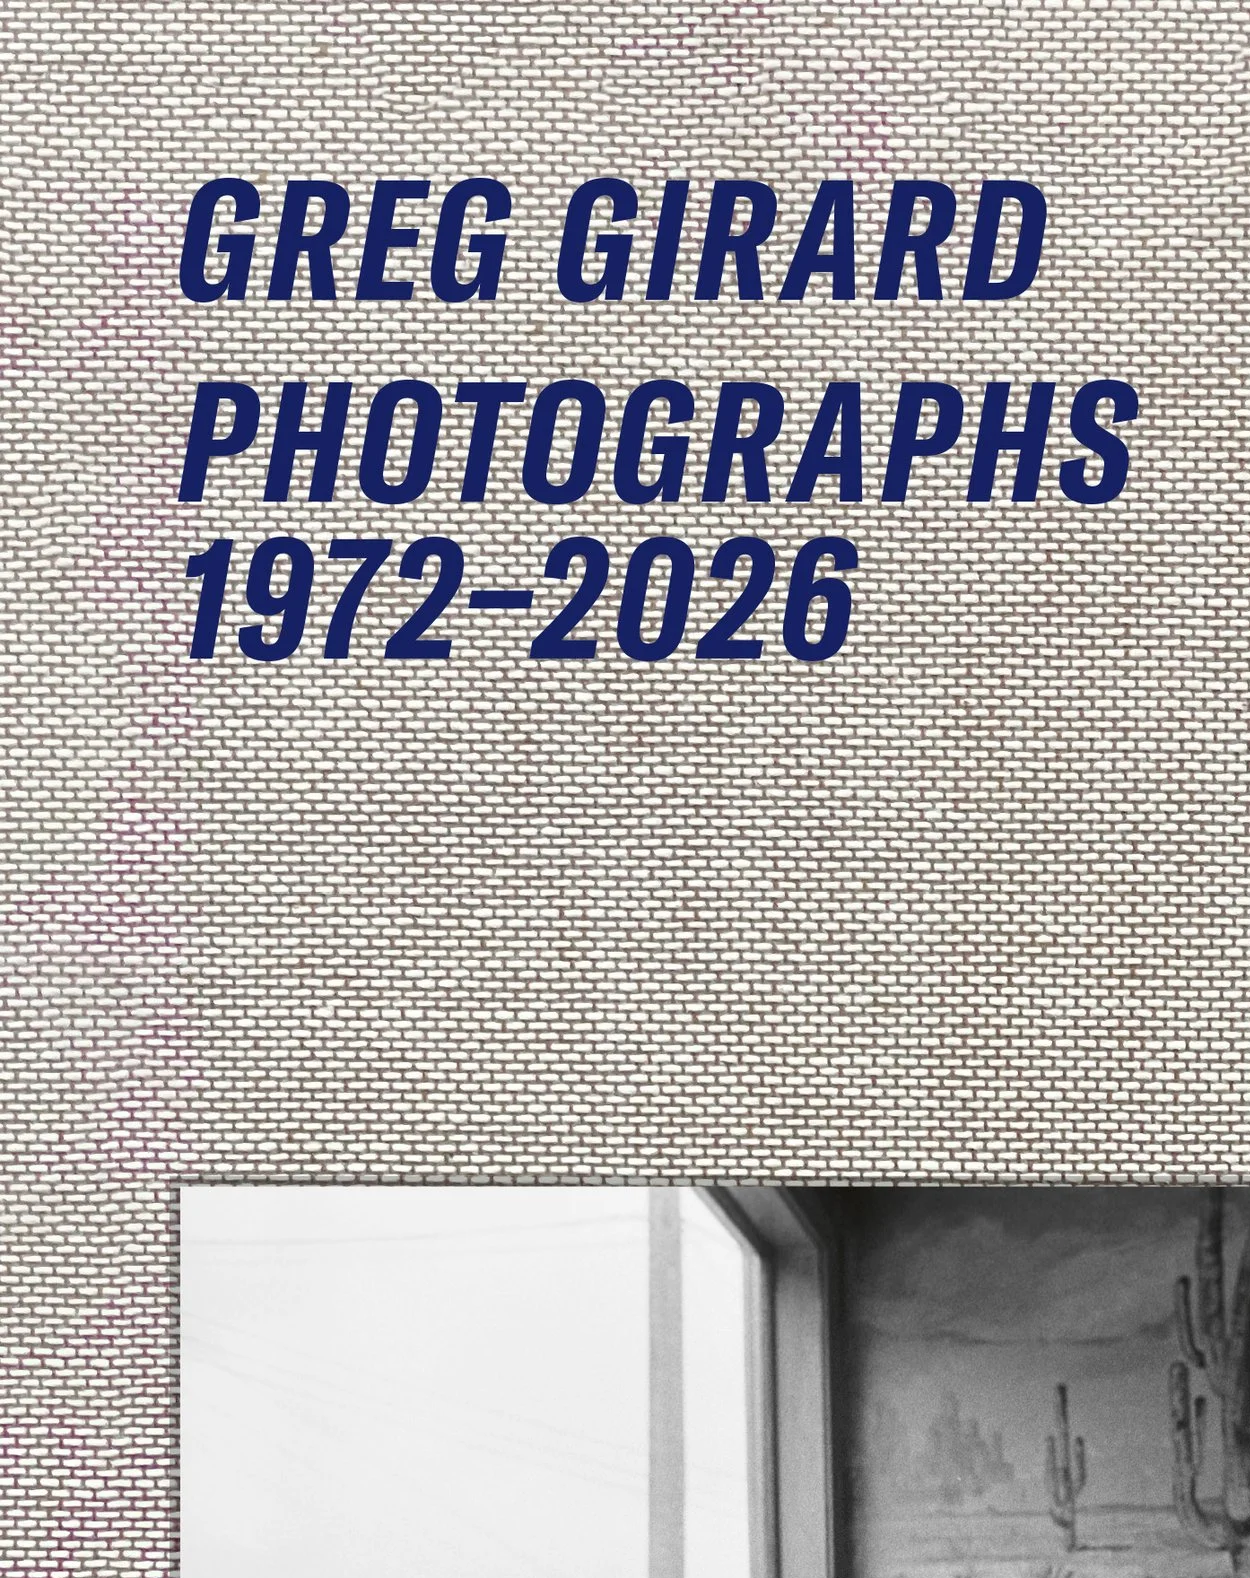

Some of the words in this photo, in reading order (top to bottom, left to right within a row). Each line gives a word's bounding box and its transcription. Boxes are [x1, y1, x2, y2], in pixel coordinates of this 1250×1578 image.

[178, 177, 512, 303] GREG
[556, 177, 1047, 303] GIRARD
[178, 379, 1139, 505] PHOTOGRAPHS
[185, 536, 858, 662] 1972–2026
